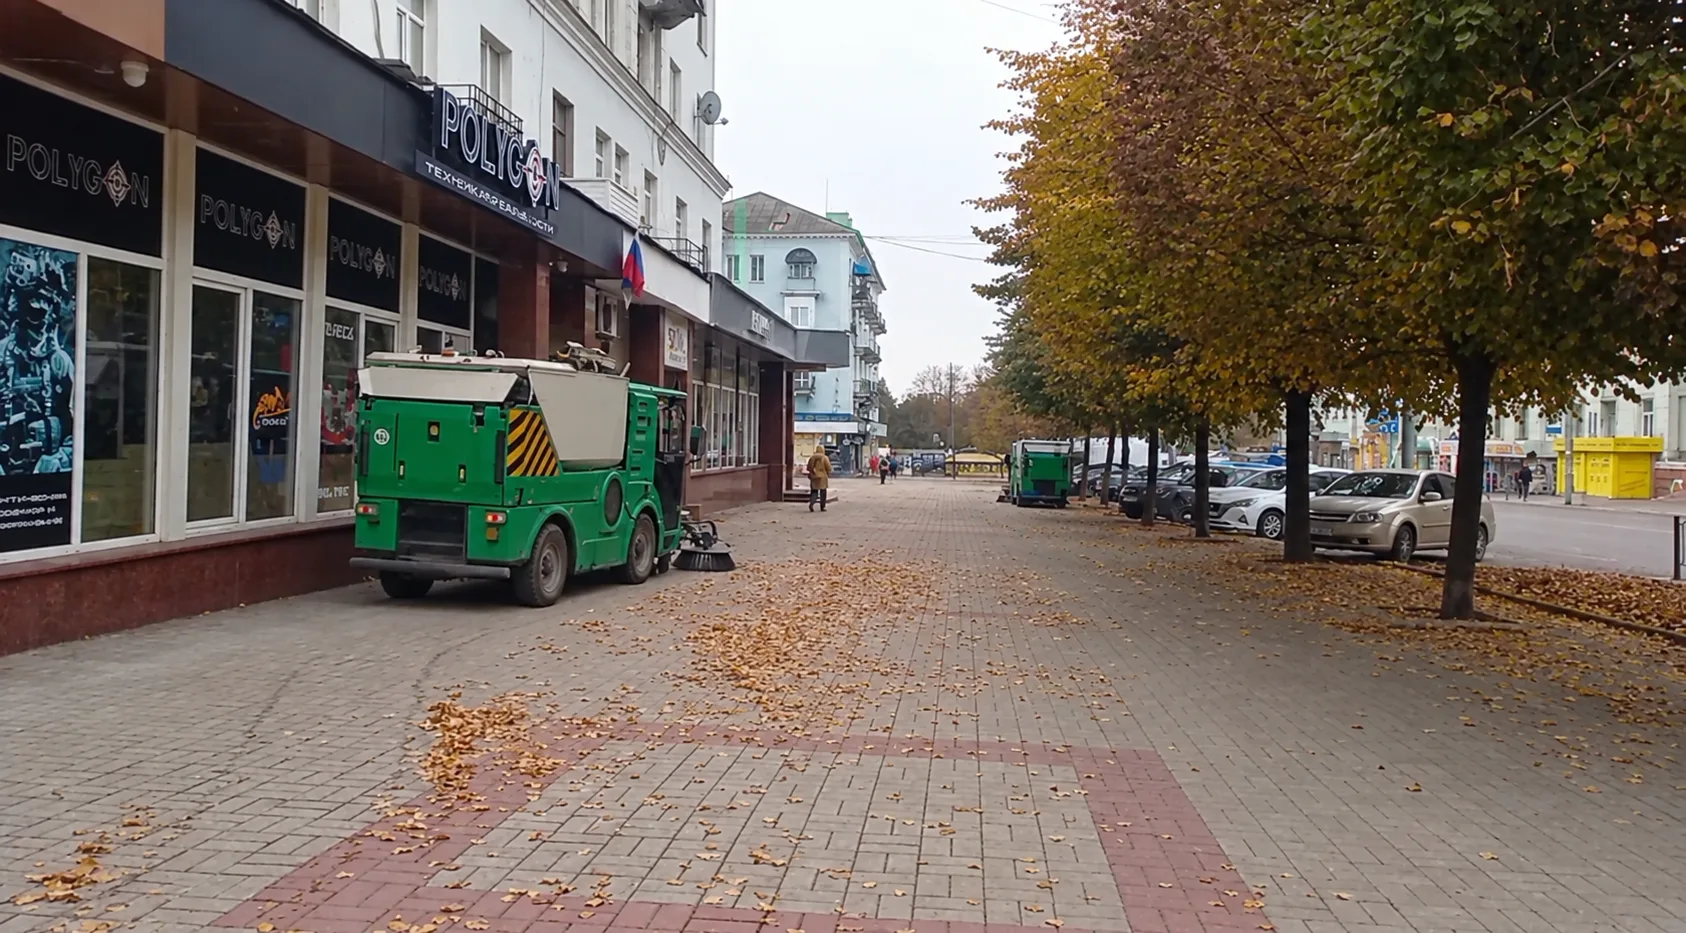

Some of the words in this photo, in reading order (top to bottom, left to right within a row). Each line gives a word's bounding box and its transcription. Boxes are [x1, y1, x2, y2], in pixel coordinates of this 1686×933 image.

[6, 133, 150, 209] POLYGON
[441, 88, 560, 211] POLYGON
[200, 194, 296, 250] POLYGON
[330, 235, 396, 280] POLYGON
